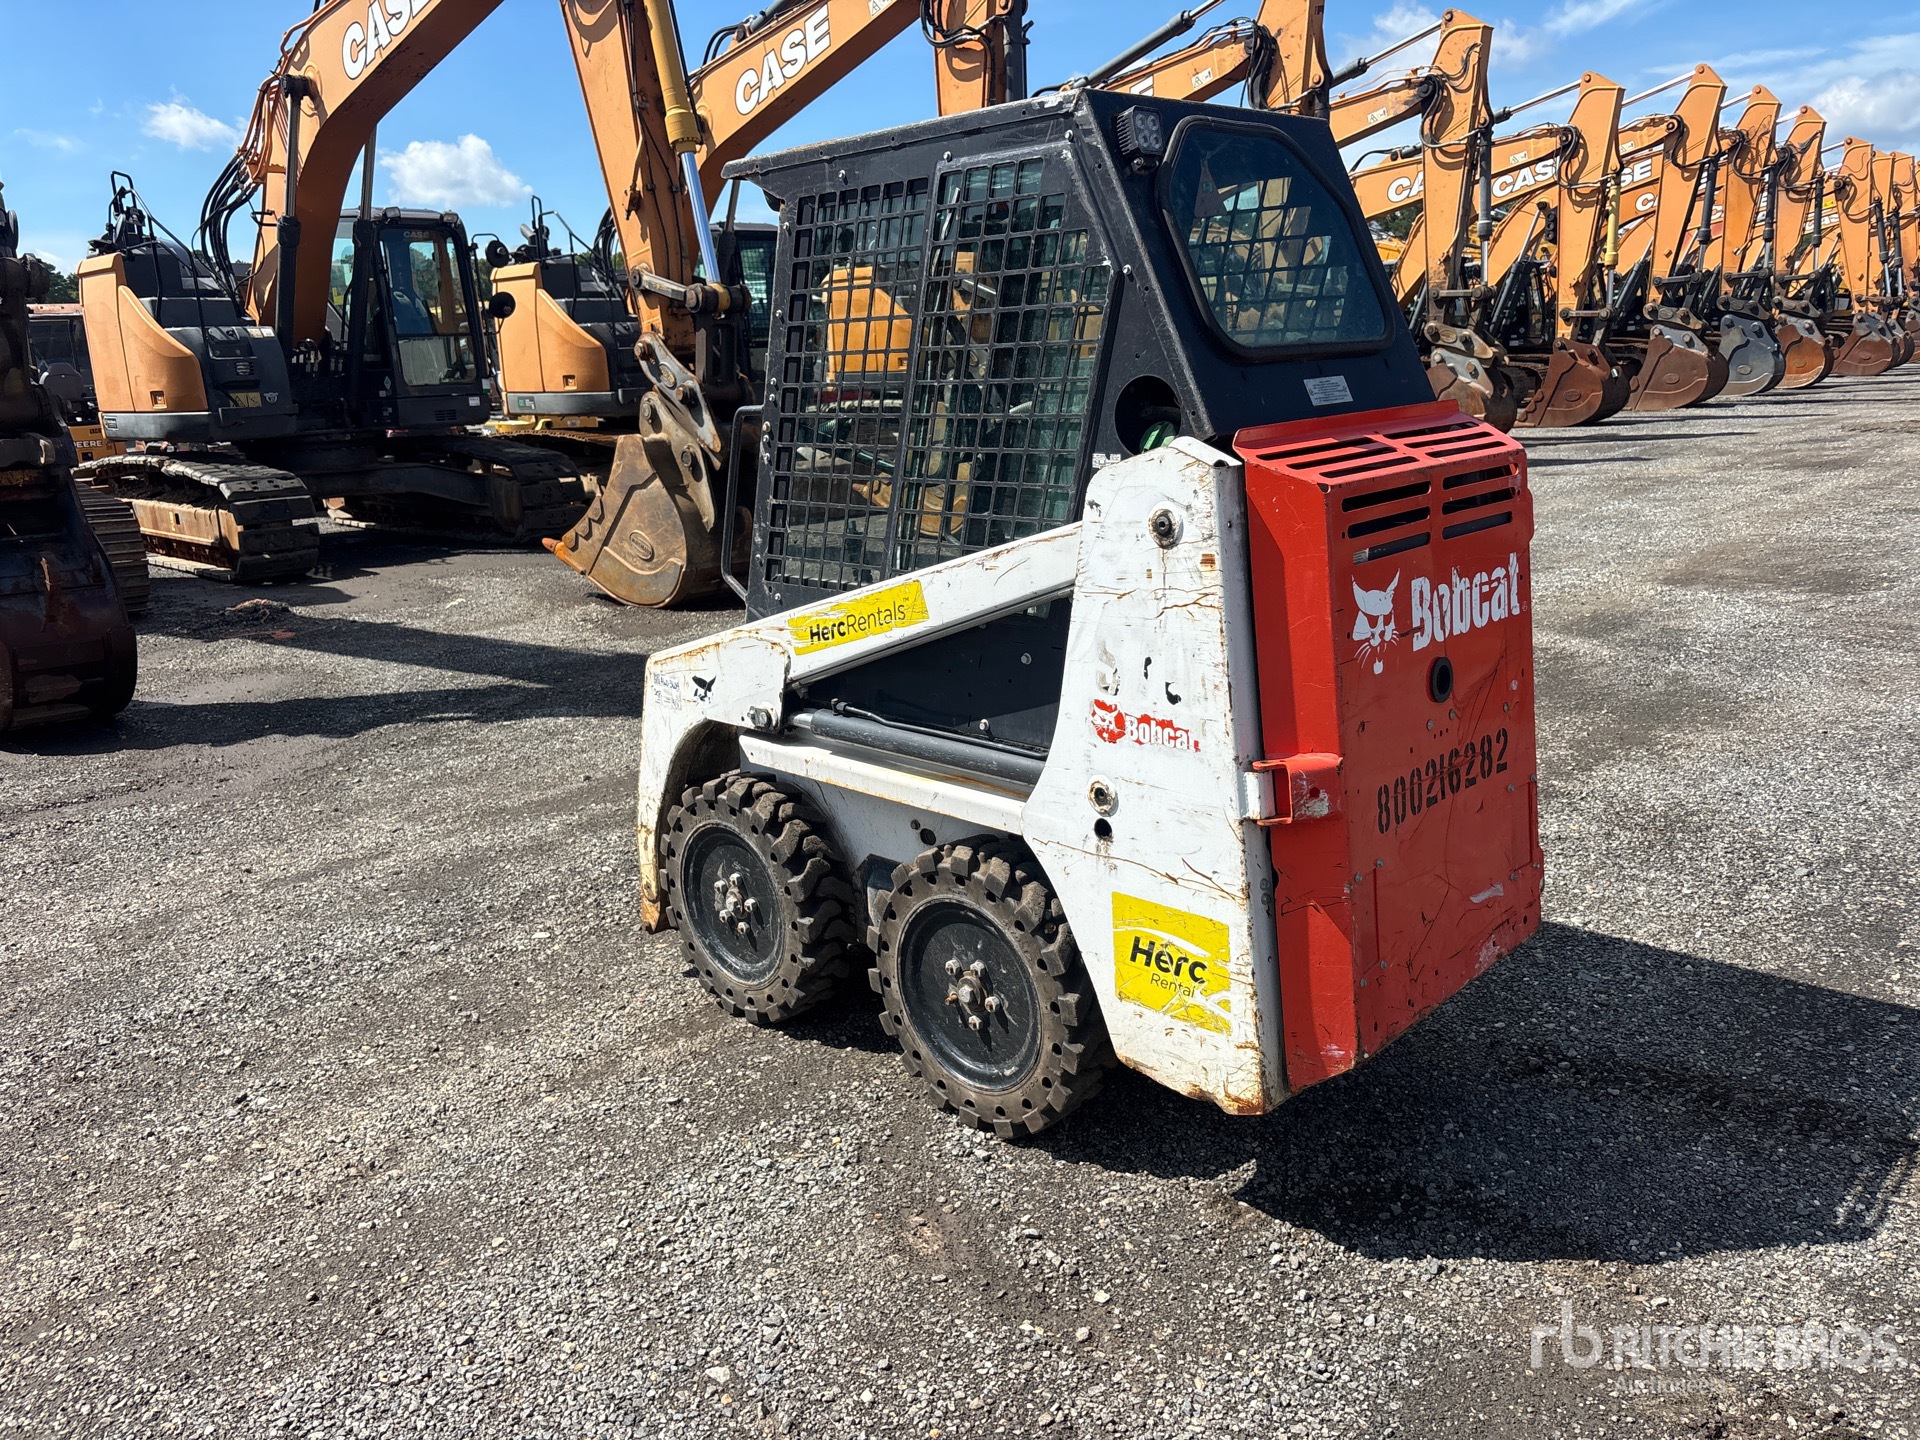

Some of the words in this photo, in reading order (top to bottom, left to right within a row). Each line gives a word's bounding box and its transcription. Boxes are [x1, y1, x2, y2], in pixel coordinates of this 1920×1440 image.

[734, 4, 832, 115] CASE
[1387, 170, 1424, 203] CA
[1492, 155, 1560, 198] CAS
[403, 231, 430, 239] CASE
[74, 440, 103, 448] EERE
[809, 600, 906, 646] HercRentals
[1411, 552, 1520, 652] Bobcat
[1377, 727, 1508, 835] 800216282
[1129, 935, 1208, 985] Herc
[1150, 972, 1197, 999] Rental
